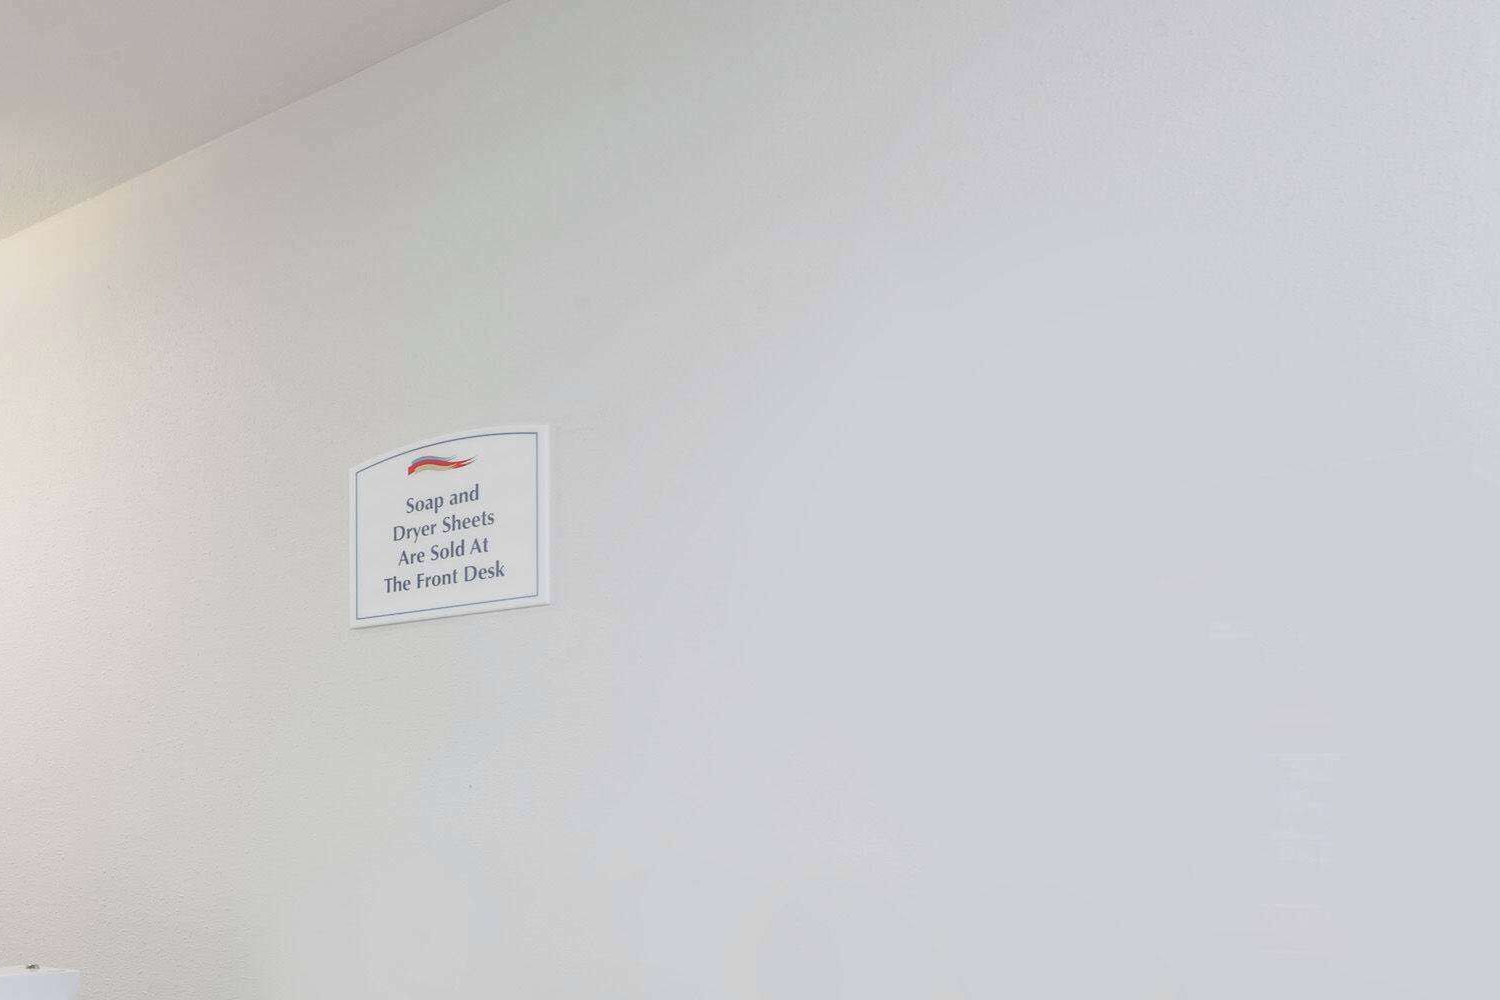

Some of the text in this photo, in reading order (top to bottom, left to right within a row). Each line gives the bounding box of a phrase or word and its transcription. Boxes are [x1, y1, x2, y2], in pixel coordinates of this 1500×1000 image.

[405, 483, 480, 514] Soap and
[393, 511, 495, 543] Dryer Sheets
[398, 537, 489, 566] Are Sold At
[384, 560, 506, 593] The Front Desk
